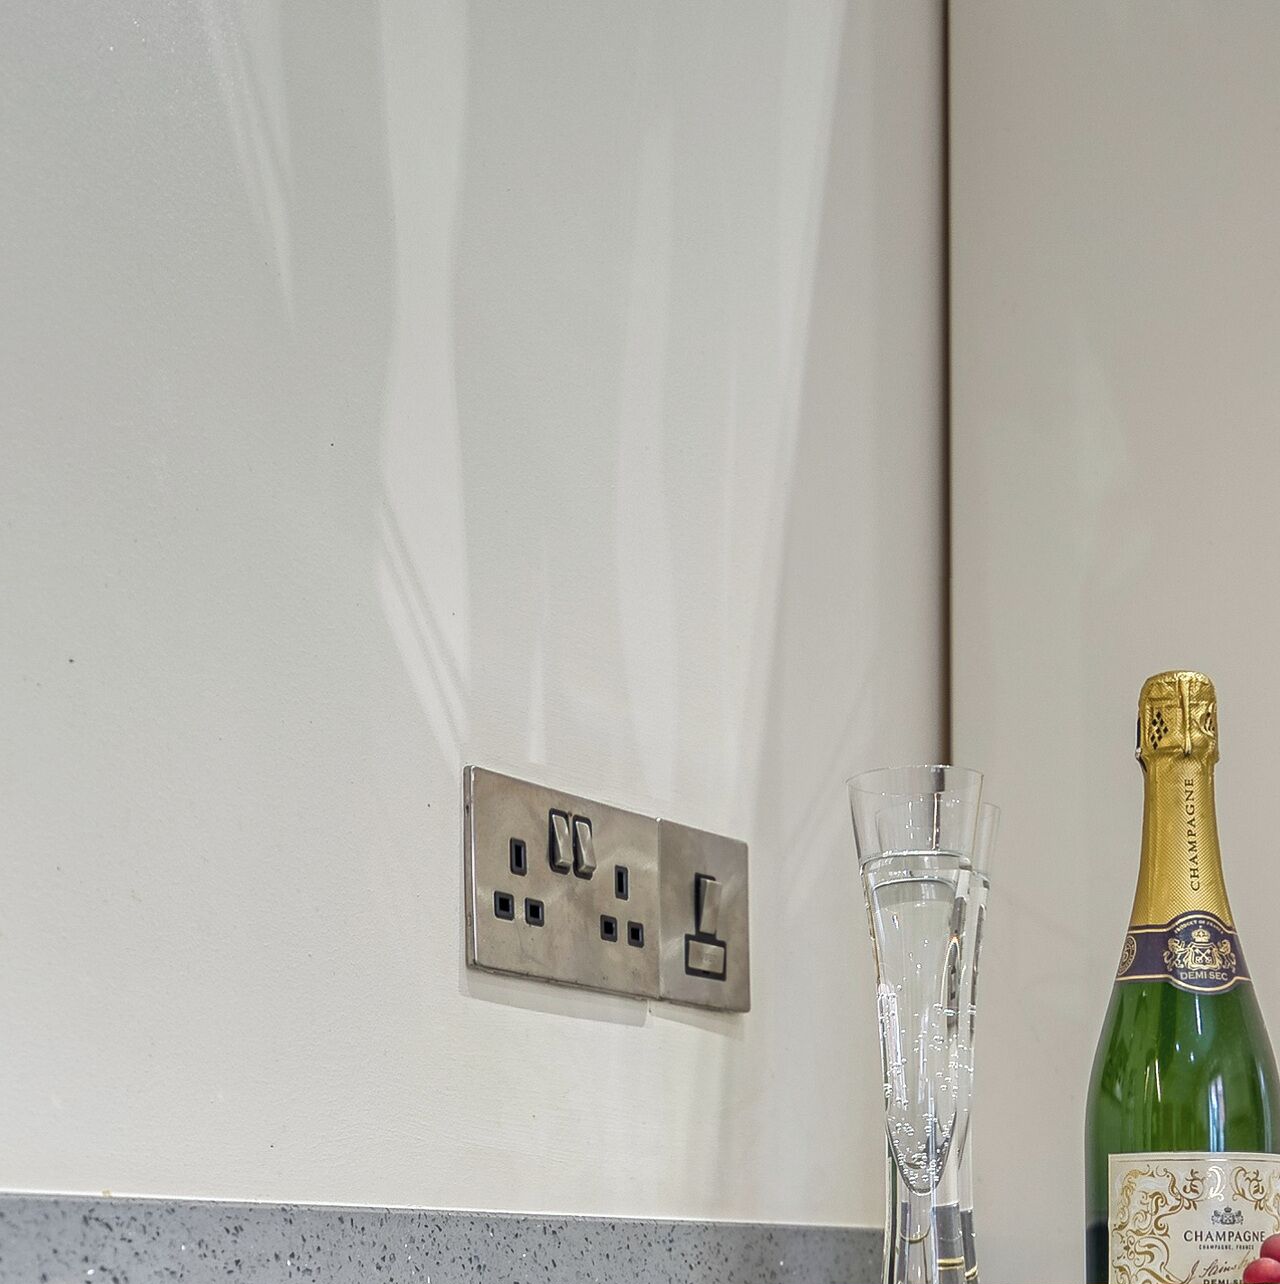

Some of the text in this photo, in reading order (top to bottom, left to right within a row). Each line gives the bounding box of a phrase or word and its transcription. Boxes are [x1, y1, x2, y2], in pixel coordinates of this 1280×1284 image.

[1184, 778, 1200, 892] CHAMPAGNE
[1179, 970, 1229, 981] DEMI SEC
[1183, 1230, 1266, 1242] CHAMPAGNE
